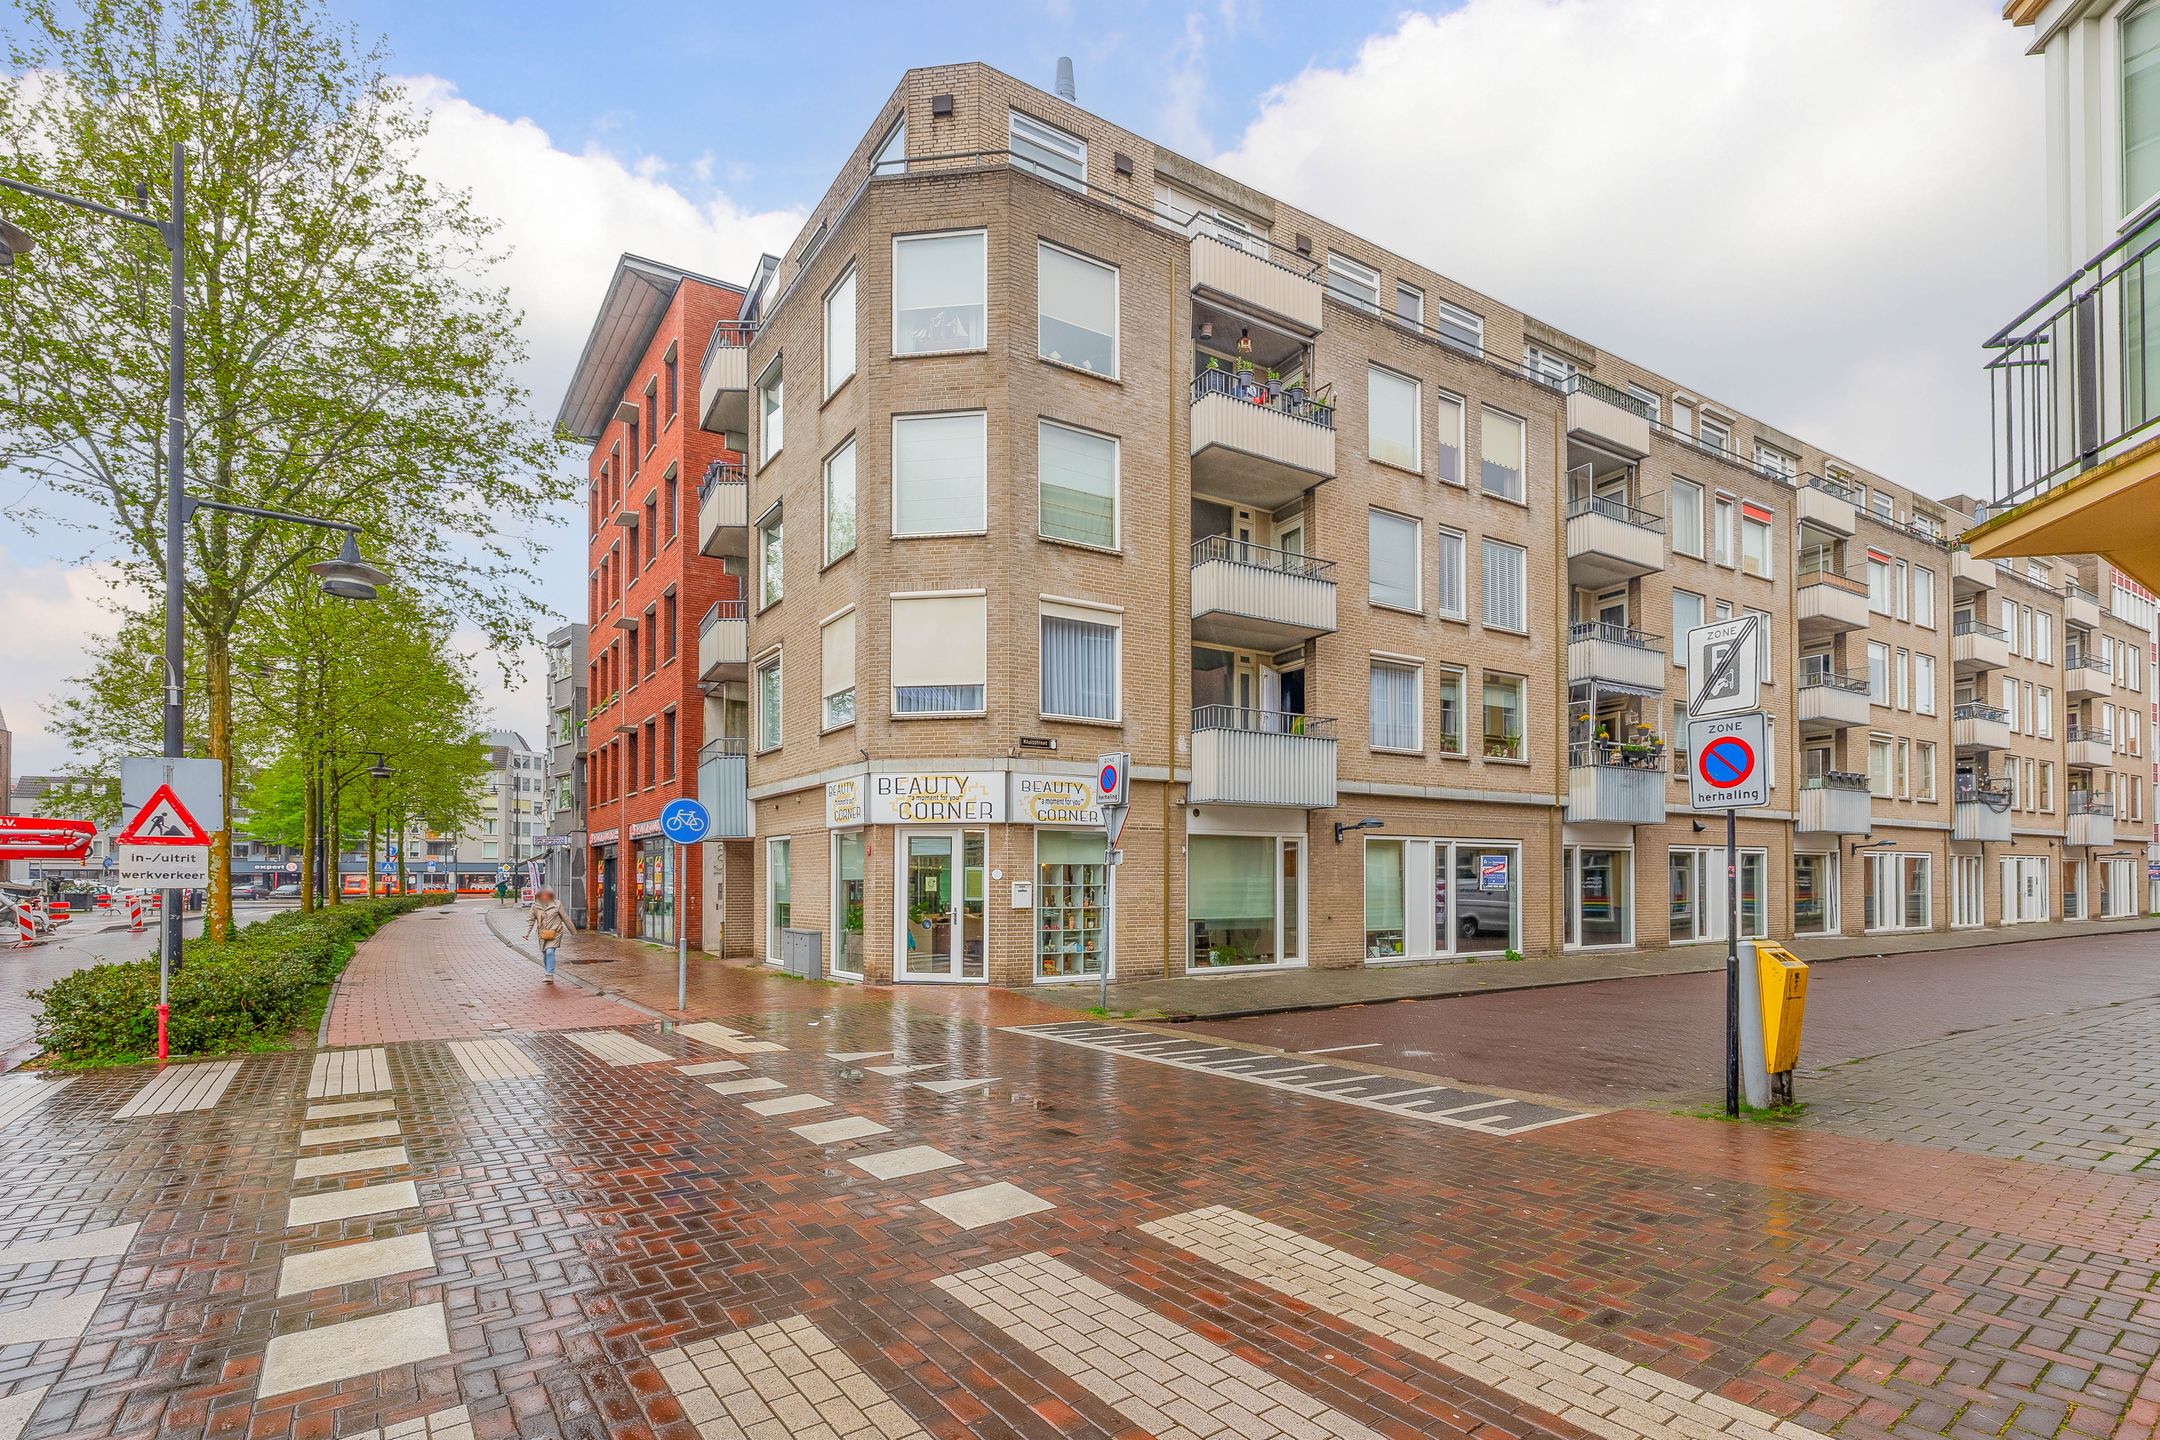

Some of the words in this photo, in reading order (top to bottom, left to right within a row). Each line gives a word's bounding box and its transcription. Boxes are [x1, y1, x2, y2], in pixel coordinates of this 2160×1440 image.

[1707, 626, 1737, 640] ZONE
[1708, 721, 1743, 734] ZONE
[828, 781, 855, 797] BEAUTY
[878, 776, 969, 795] BEAUTY
[1021, 780, 1084, 794] BEAUTY
[1064, 797, 1072, 805] for
[1698, 790, 1759, 802] herhaling
[834, 806, 861, 821] CORNER
[899, 801, 993, 820] CORNER
[1037, 809, 1098, 822] CORNER
[131, 853, 197, 863] in-/uitrit
[121, 871, 206, 880] werkverkeer
